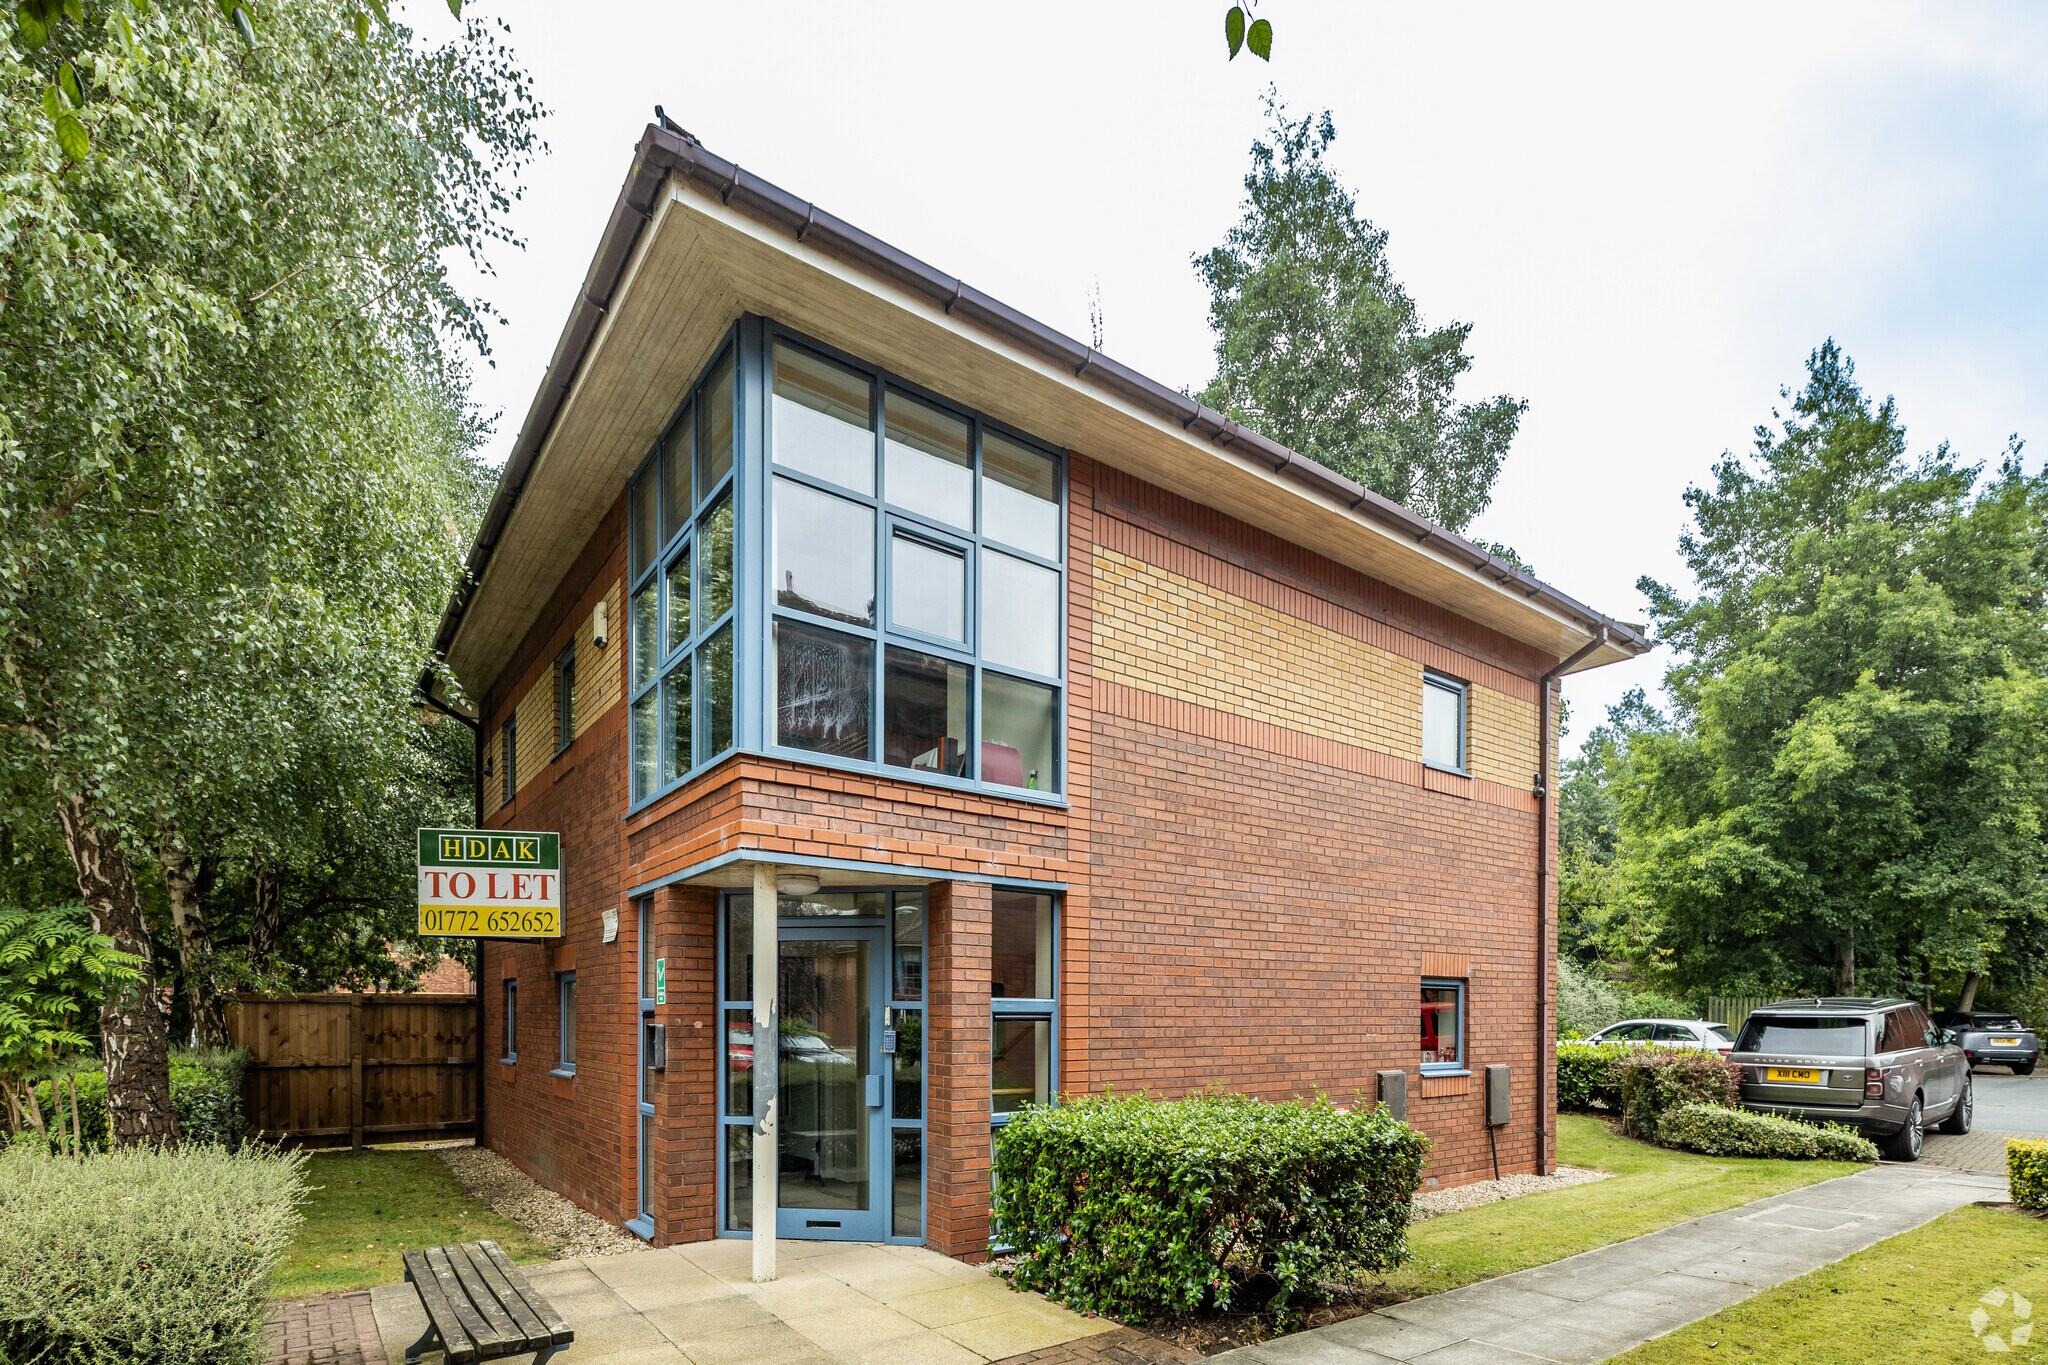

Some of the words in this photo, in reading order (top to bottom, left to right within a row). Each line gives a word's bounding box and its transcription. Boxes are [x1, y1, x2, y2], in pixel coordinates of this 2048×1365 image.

[443, 839, 536, 860] HDAK
[424, 871, 476, 899] TO
[486, 873, 556, 900] LET
[425, 910, 480, 931] 01772
[487, 911, 554, 932] 652652
